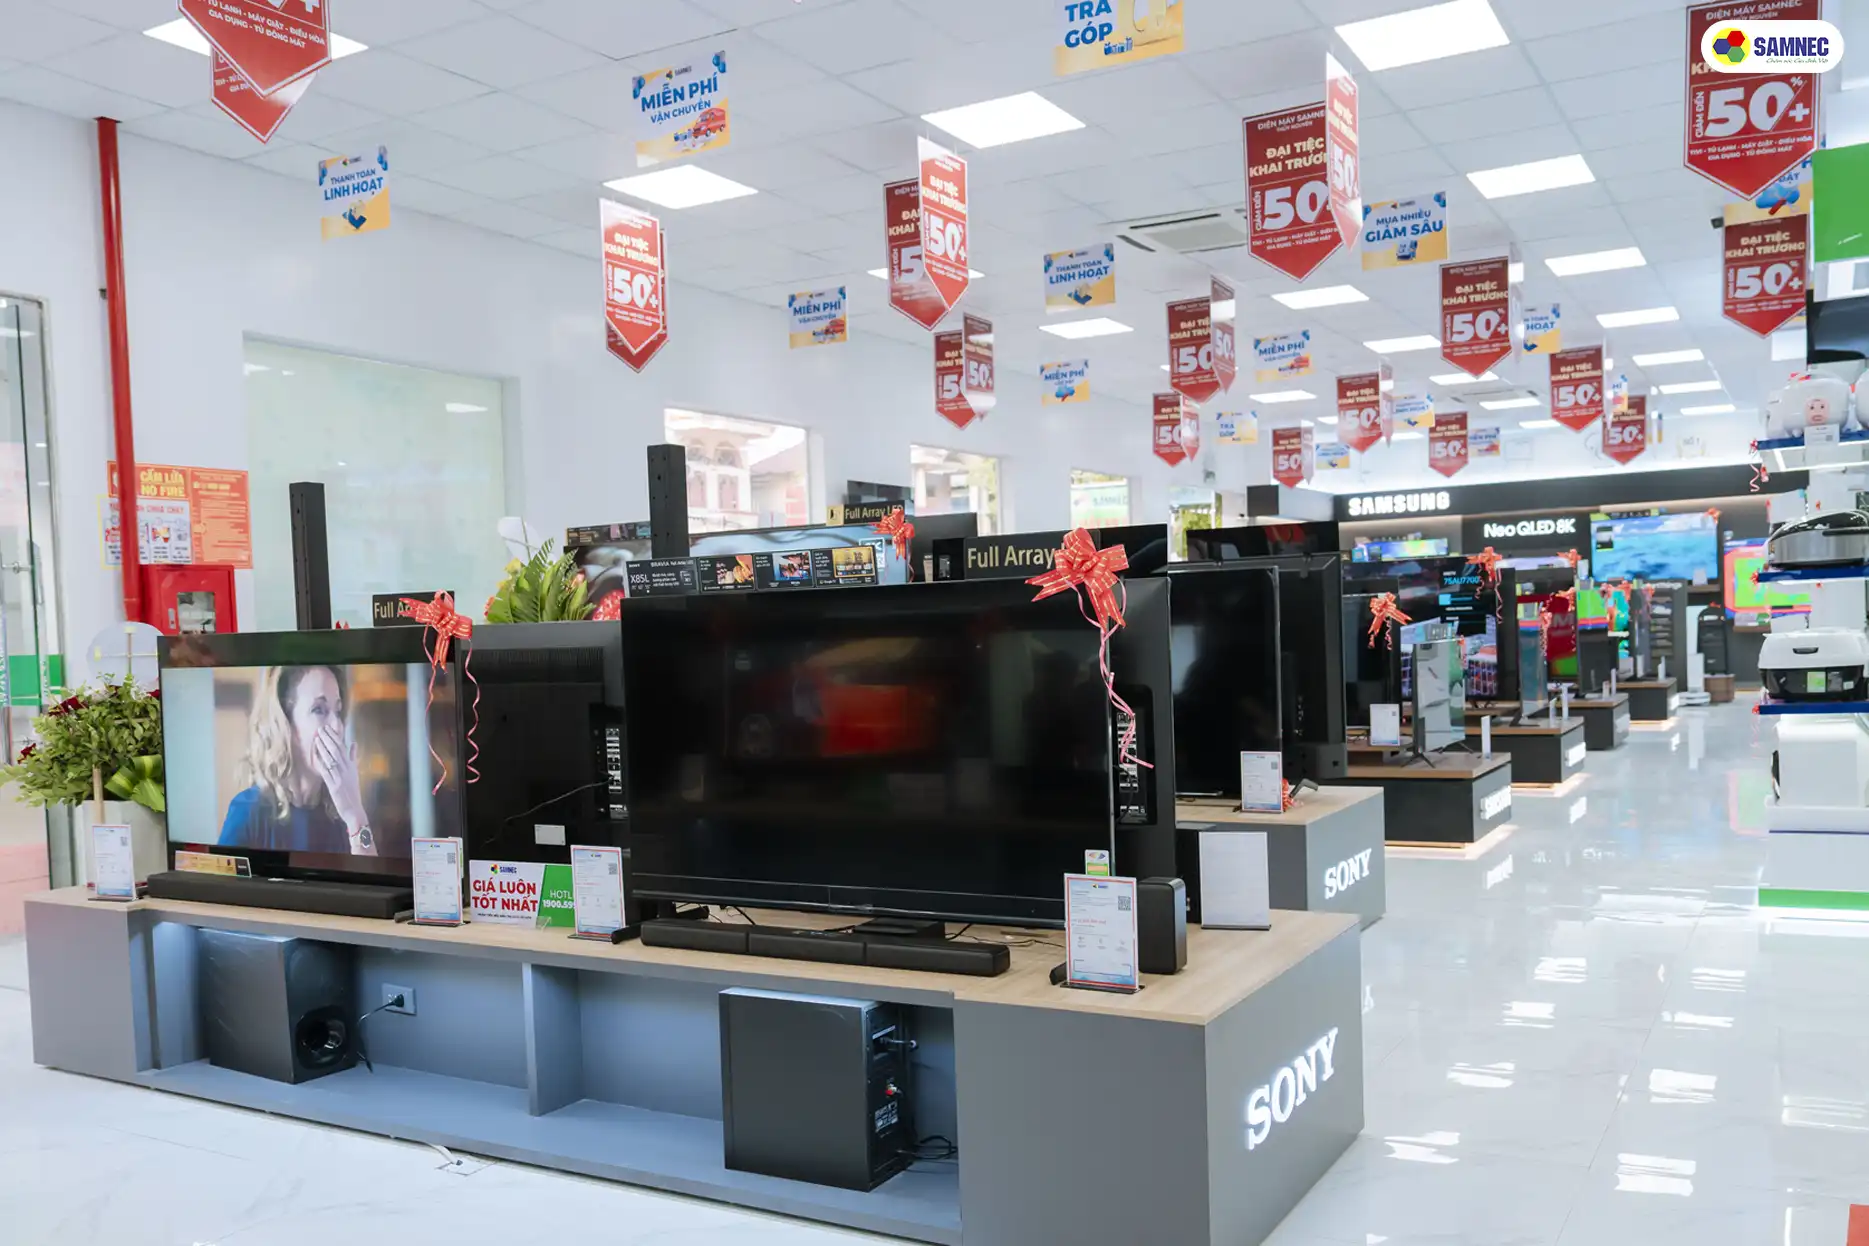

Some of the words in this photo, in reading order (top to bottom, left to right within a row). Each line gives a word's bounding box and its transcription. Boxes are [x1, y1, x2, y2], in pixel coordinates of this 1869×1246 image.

[1065, 21, 1113, 48] GÓP
[1690, 60, 1718, 75] KH
[641, 83, 685, 112] MIỄN
[689, 72, 718, 99] PHÍ
[650, 110, 671, 125] VẬN
[672, 98, 711, 118] CHUYỂN
[1296, 110, 1325, 121] SAMNE
[1266, 144, 1291, 159] ĐẠI
[1294, 137, 1324, 153] TIỆC
[1249, 161, 1282, 177] KHAI
[1285, 152, 1328, 170] TRƯƠ
[324, 184, 350, 201] LINH
[352, 177, 383, 195] HOẠT
[330, 174, 355, 185] THANH
[888, 223, 915, 237] KHAI
[1365, 224, 1407, 242] GIẢM
[1411, 219, 1443, 236] SÂU
[1376, 216, 1398, 226] MUA
[1740, 235, 1762, 246] ĐẠI
[1764, 230, 1790, 242] TIỆC
[1725, 247, 1753, 258] KHAI
[1049, 272, 1076, 284] LINH
[1078, 265, 1110, 280] HOẠT
[1056, 264, 1080, 272] THANH
[141, 484, 158, 497] NO
[845, 508, 860, 519] Full
[862, 507, 885, 519] Array
[1348, 491, 1450, 516] SAMSUNG
[1483, 522, 1515, 539] Neo
[1517, 519, 1555, 535] QLED
[1556, 517, 1576, 534] 8K
[967, 545, 999, 568] Full
[1004, 545, 1056, 569] Array
[374, 602, 394, 619] Full
[1324, 848, 1372, 899] SONY
[472, 877, 496, 893] GIÁ
[499, 878, 536, 895] LUÔN
[550, 889, 572, 899] HOTL
[472, 892, 498, 910] TỐT
[501, 895, 538, 912] NHẤT
[1248, 1027, 1338, 1150] SONY
